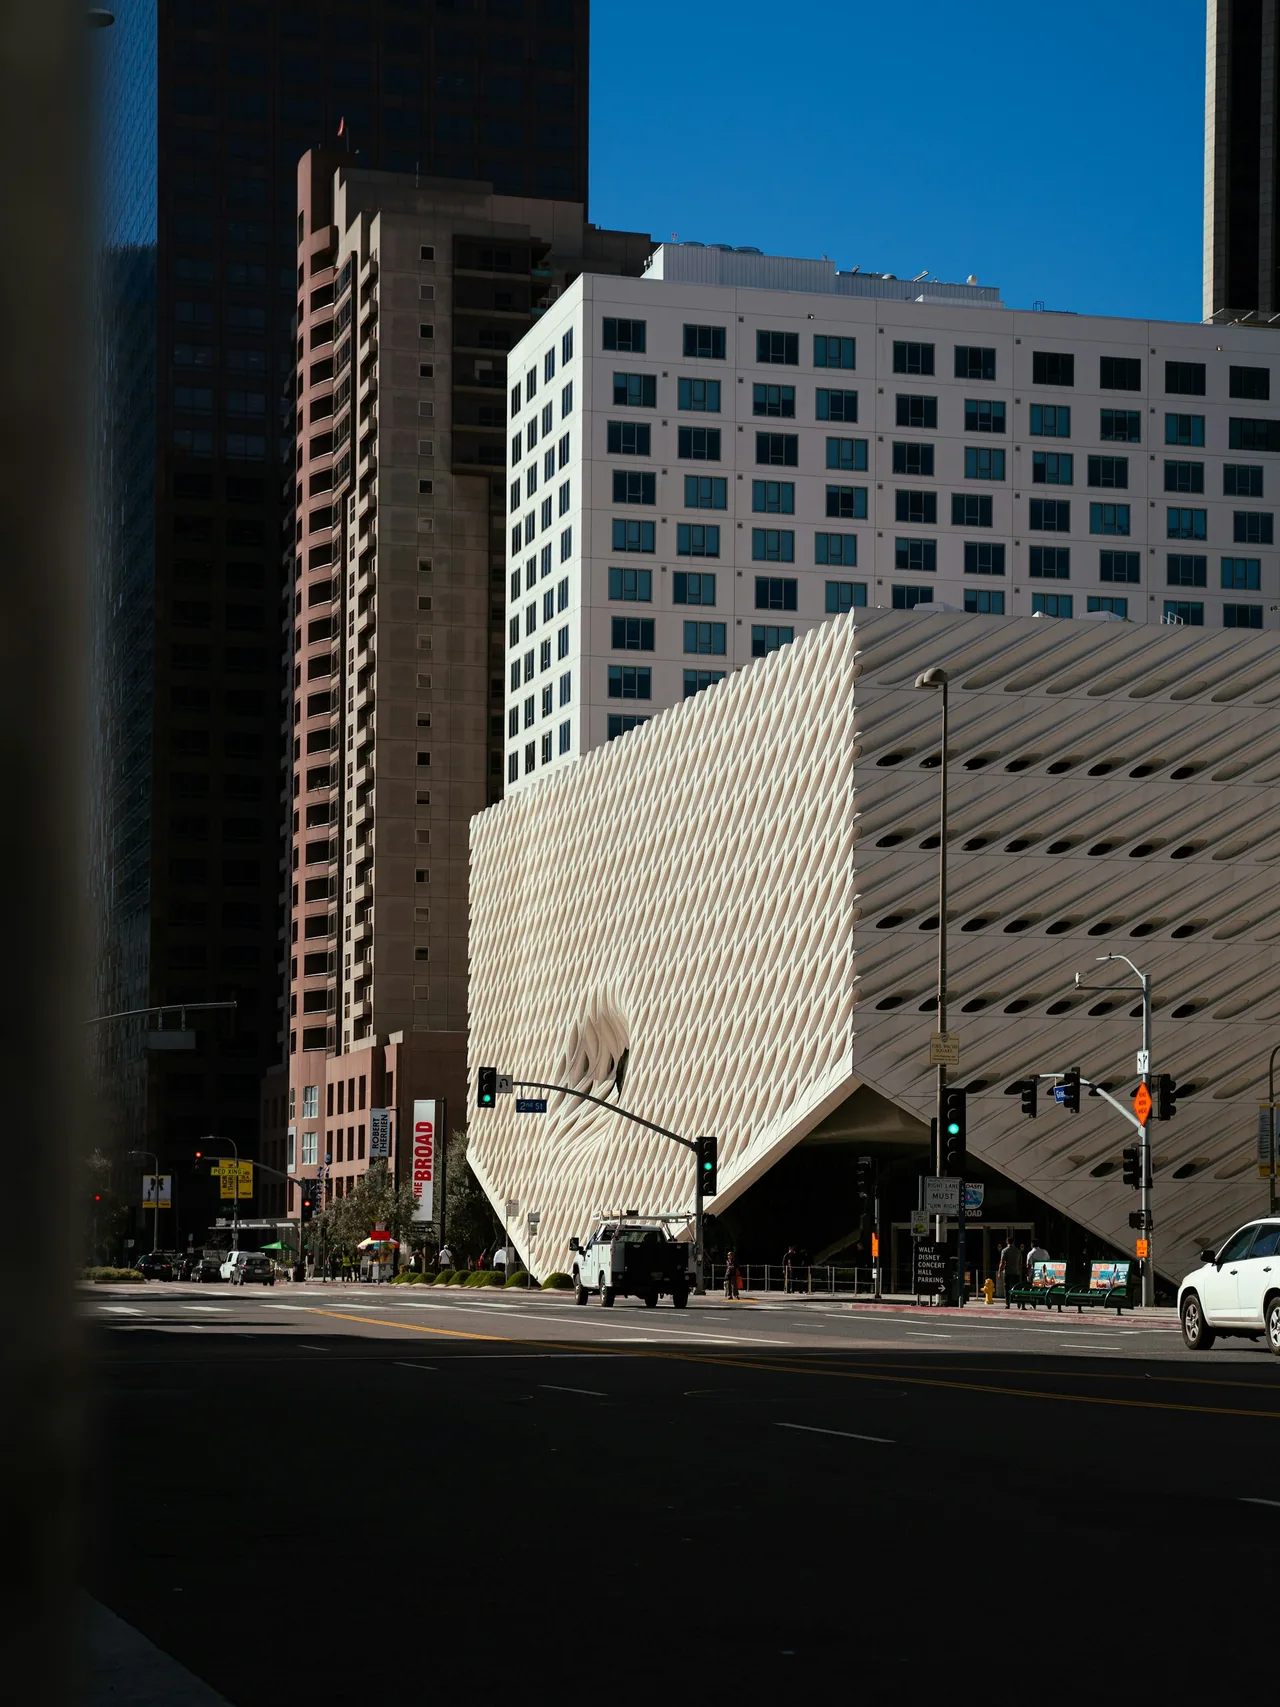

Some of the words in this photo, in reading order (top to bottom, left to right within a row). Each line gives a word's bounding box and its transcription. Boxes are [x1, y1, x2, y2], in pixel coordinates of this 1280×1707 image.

[520, 1101, 533, 1111] 2nd
[535, 1102, 543, 1110] St
[372, 1117, 380, 1149] ROBERT
[379, 1114, 388, 1153] THERRIEN
[414, 1121, 433, 1182] BROAD
[413, 1182, 423, 1199] THE
[917, 1261, 946, 1269] CONCERT
[917, 1276, 944, 1284] PARKING
